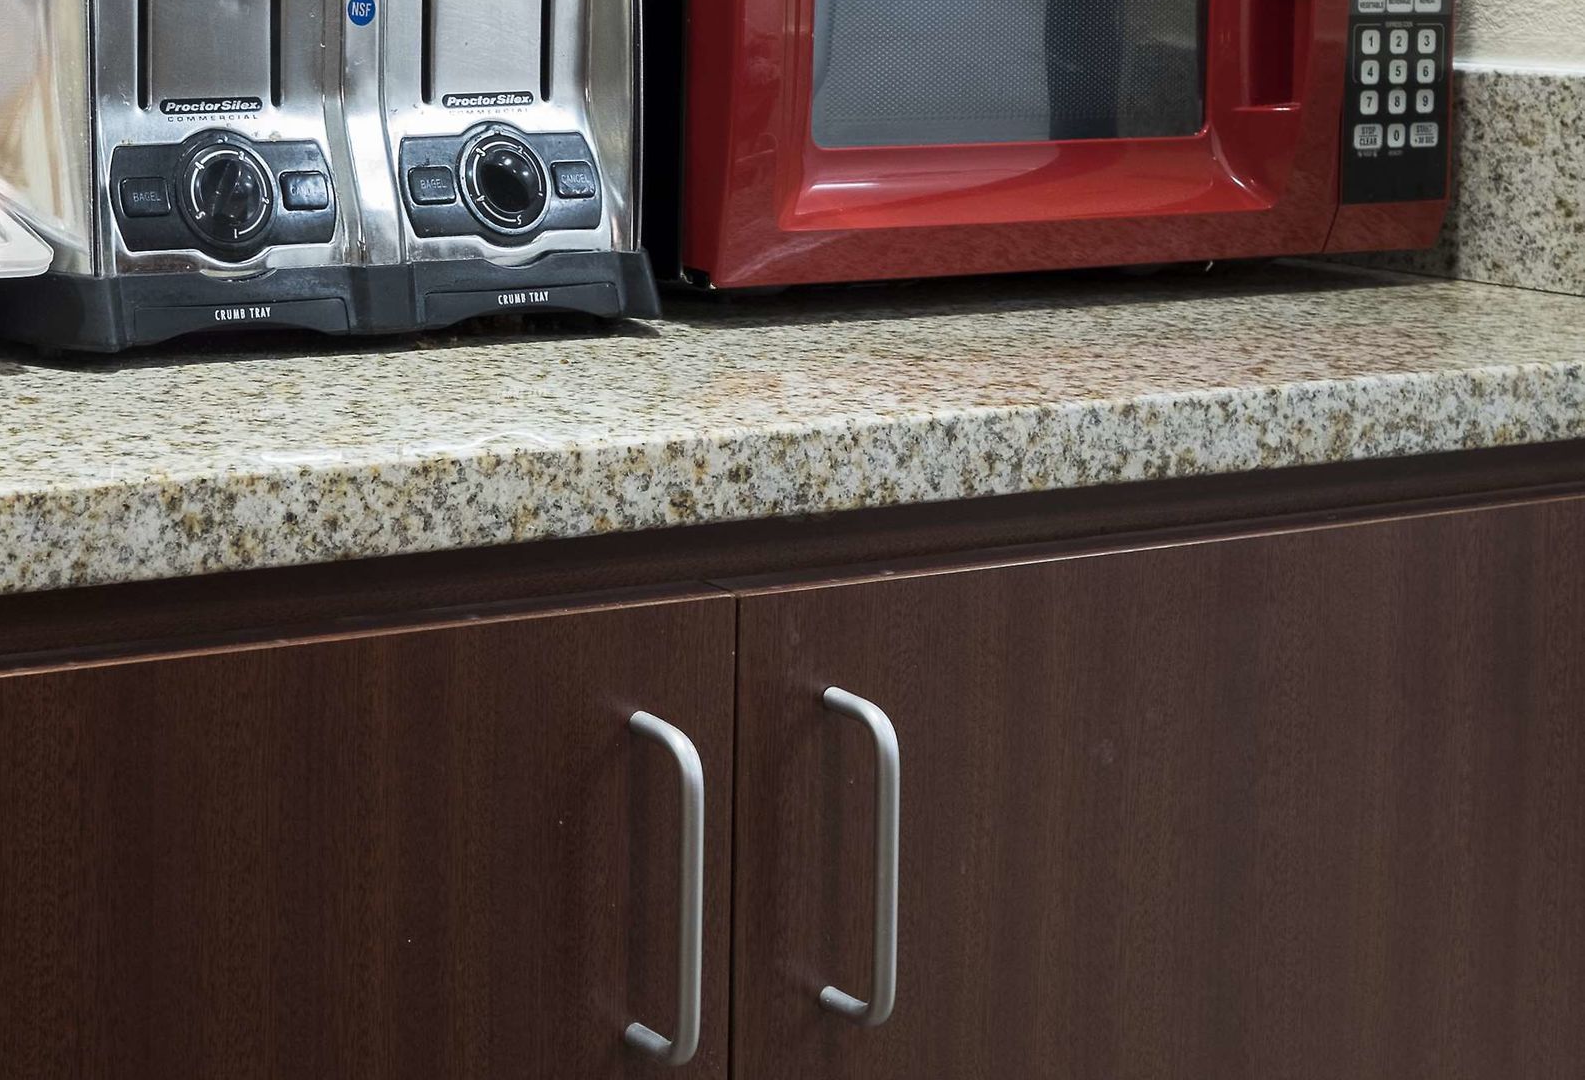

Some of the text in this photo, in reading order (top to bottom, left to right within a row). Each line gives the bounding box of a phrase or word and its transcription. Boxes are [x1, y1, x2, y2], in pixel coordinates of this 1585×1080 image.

[351, 2, 372, 17] NSF
[1369, 35, 1374, 47] 1
[1396, 35, 1402, 47] 2
[1424, 35, 1430, 46] 3
[1367, 66, 1373, 77] 4
[1395, 66, 1401, 77] 5
[1423, 66, 1429, 77] 6
[1366, 96, 1372, 108] 7
[1394, 96, 1400, 107] 8
[1422, 95, 1428, 107] 9
[167, 114, 259, 122] COMMERCIAL
[1361, 126, 1376, 135] STOP
[1394, 129, 1400, 141] 0
[1359, 138, 1377, 146] CLEAR
[420, 179, 447, 188] BAGEL
[561, 174, 591, 184] CANCEL
[132, 192, 162, 202] BAGEL
[498, 291, 549, 305] CRUMB TRAY
[215, 307, 271, 321] CRUMB TRAY
